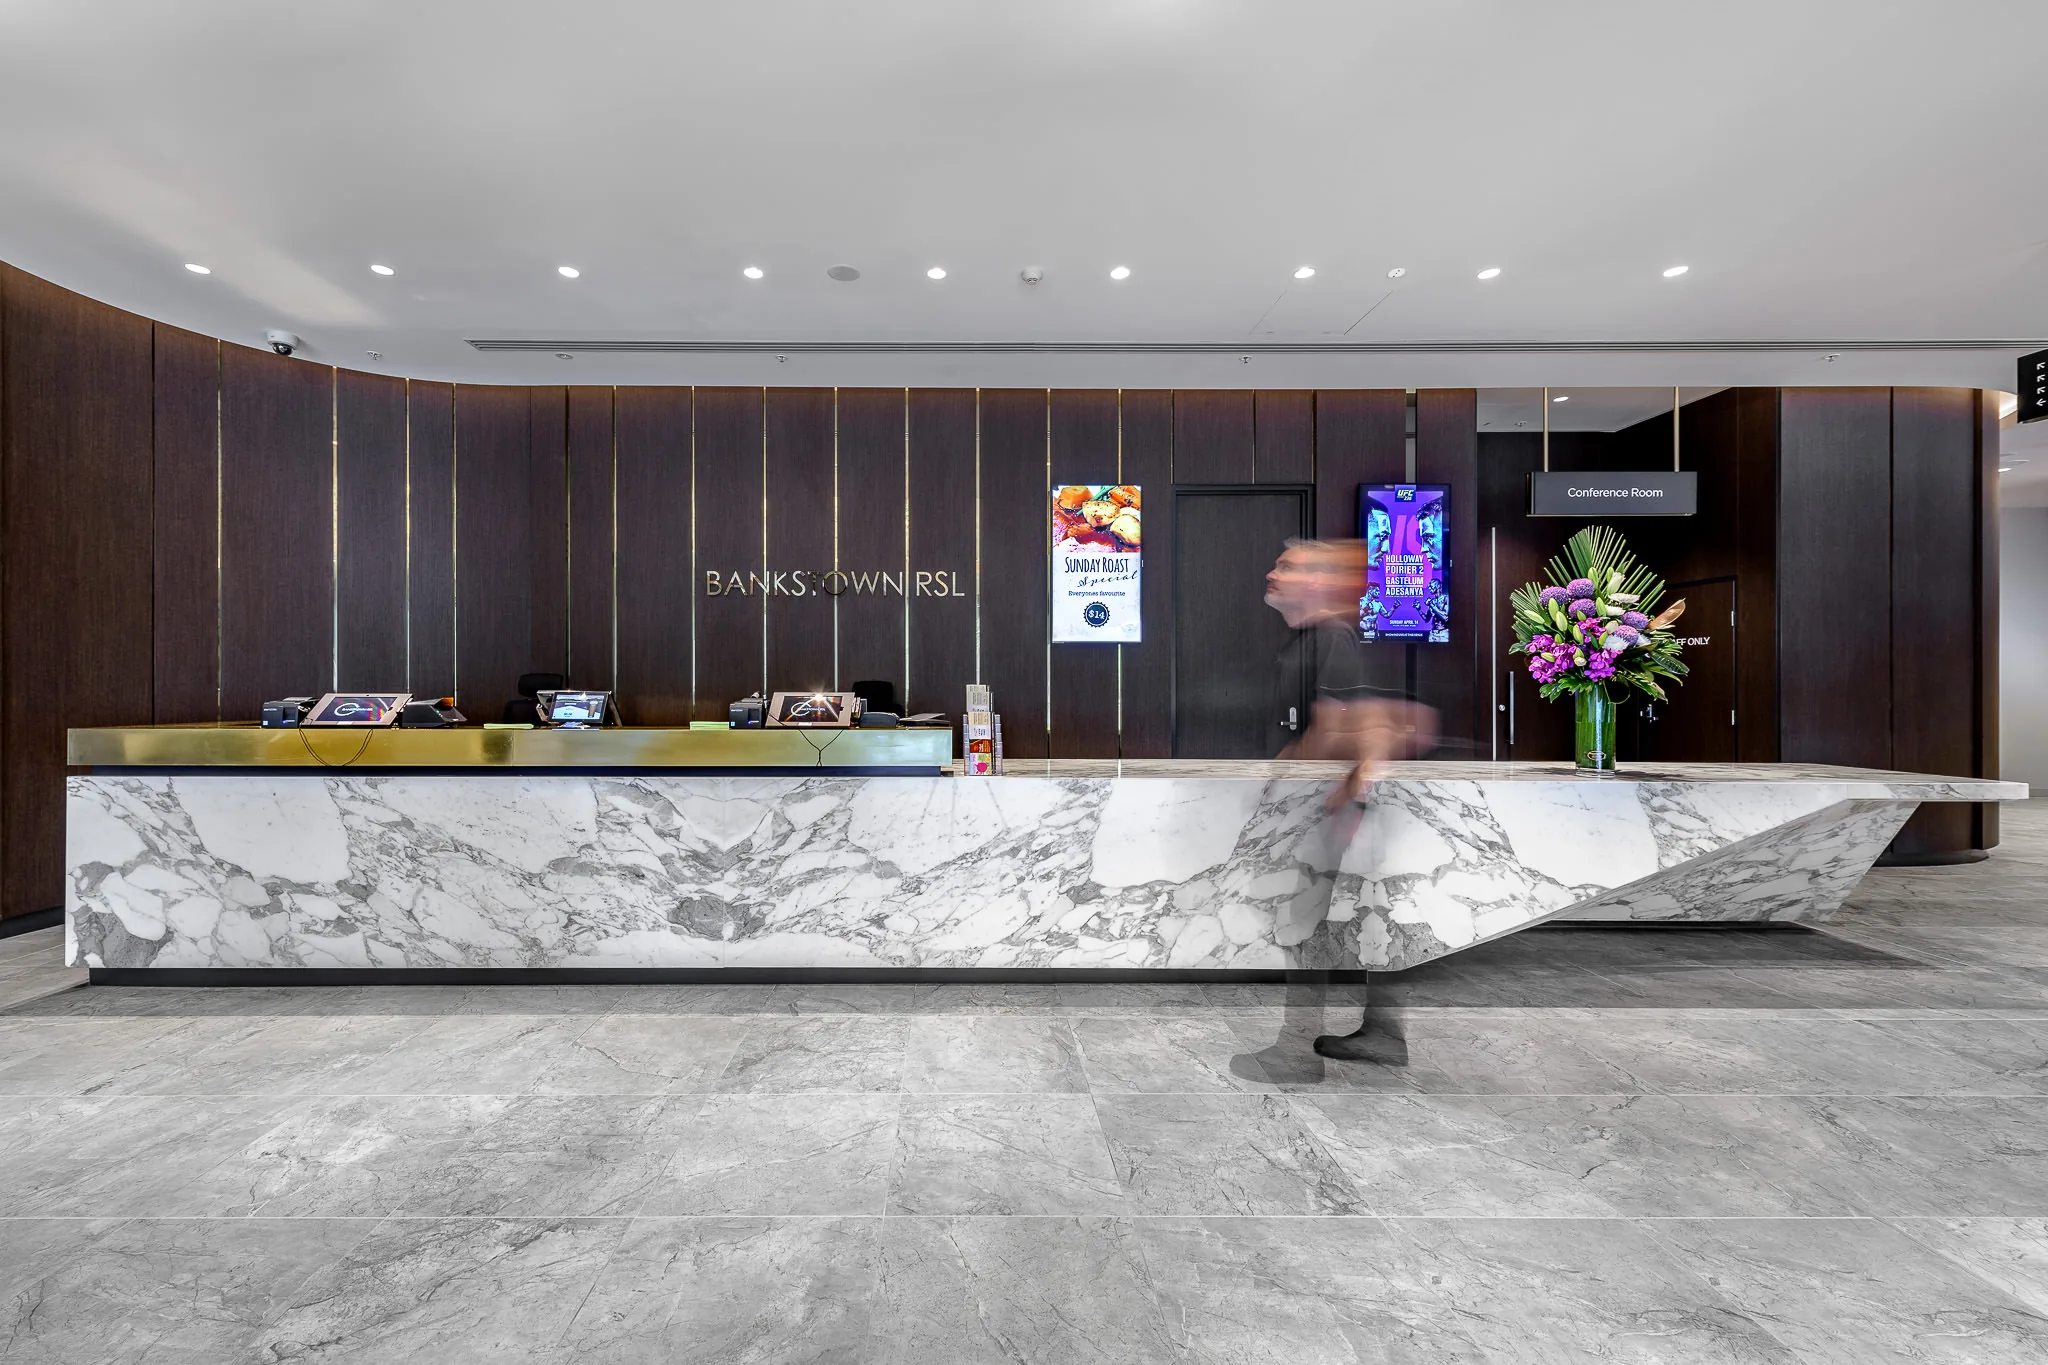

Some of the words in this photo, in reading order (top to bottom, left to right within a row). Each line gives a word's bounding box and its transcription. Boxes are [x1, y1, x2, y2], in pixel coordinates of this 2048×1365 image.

[1397, 489, 1415, 497] UFC
[1567, 487, 1629, 498] Conference
[1631, 487, 1663, 498] Room
[1385, 554, 1424, 563] HOLLOWAY
[1065, 556, 1100, 573] SUNDAY
[1102, 556, 1129, 573] ROAST
[1385, 565, 1417, 574] POIRIER
[1418, 565, 1424, 574] 2
[705, 570, 904, 597] BANKSTOWN
[916, 571, 965, 597] RSL
[1385, 576, 1424, 585] GASTELUM
[1385, 587, 1424, 596] ADESANYA
[1088, 609, 1105, 620] $14
[1687, 636, 1711, 646] ONLY
